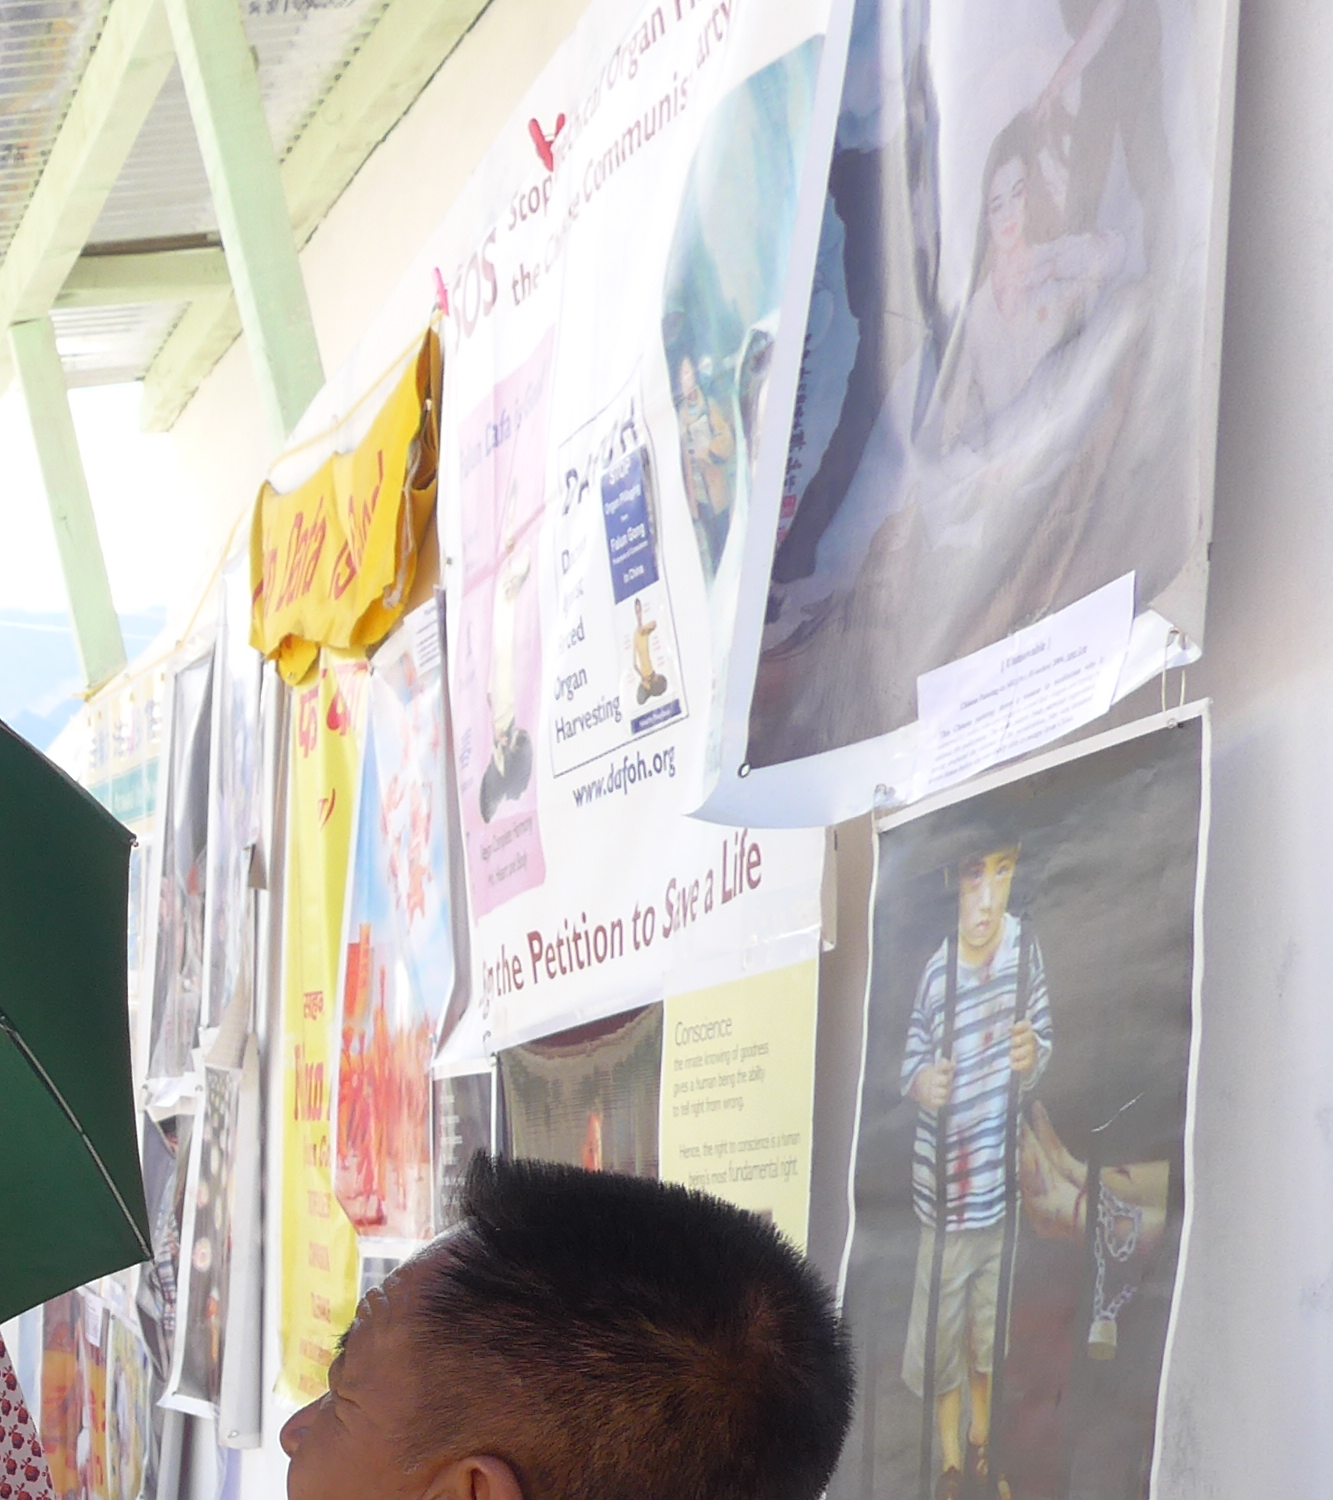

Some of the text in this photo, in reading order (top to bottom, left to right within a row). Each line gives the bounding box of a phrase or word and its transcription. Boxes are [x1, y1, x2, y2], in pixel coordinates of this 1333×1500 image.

[607, 5, 666, 91] Organ
[511, 262, 541, 306] the
[583, 71, 690, 203] Communis
[554, 694, 621, 743] Harvesting
[572, 745, 676, 808] www.dafoh.org
[496, 944, 525, 998] the
[527, 911, 624, 985] Petition
[632, 899, 656, 951] to
[704, 868, 714, 914] a
[720, 827, 763, 905] Life
[674, 1017, 733, 1047] Conscience
[727, 1156, 779, 1183] fundamental
